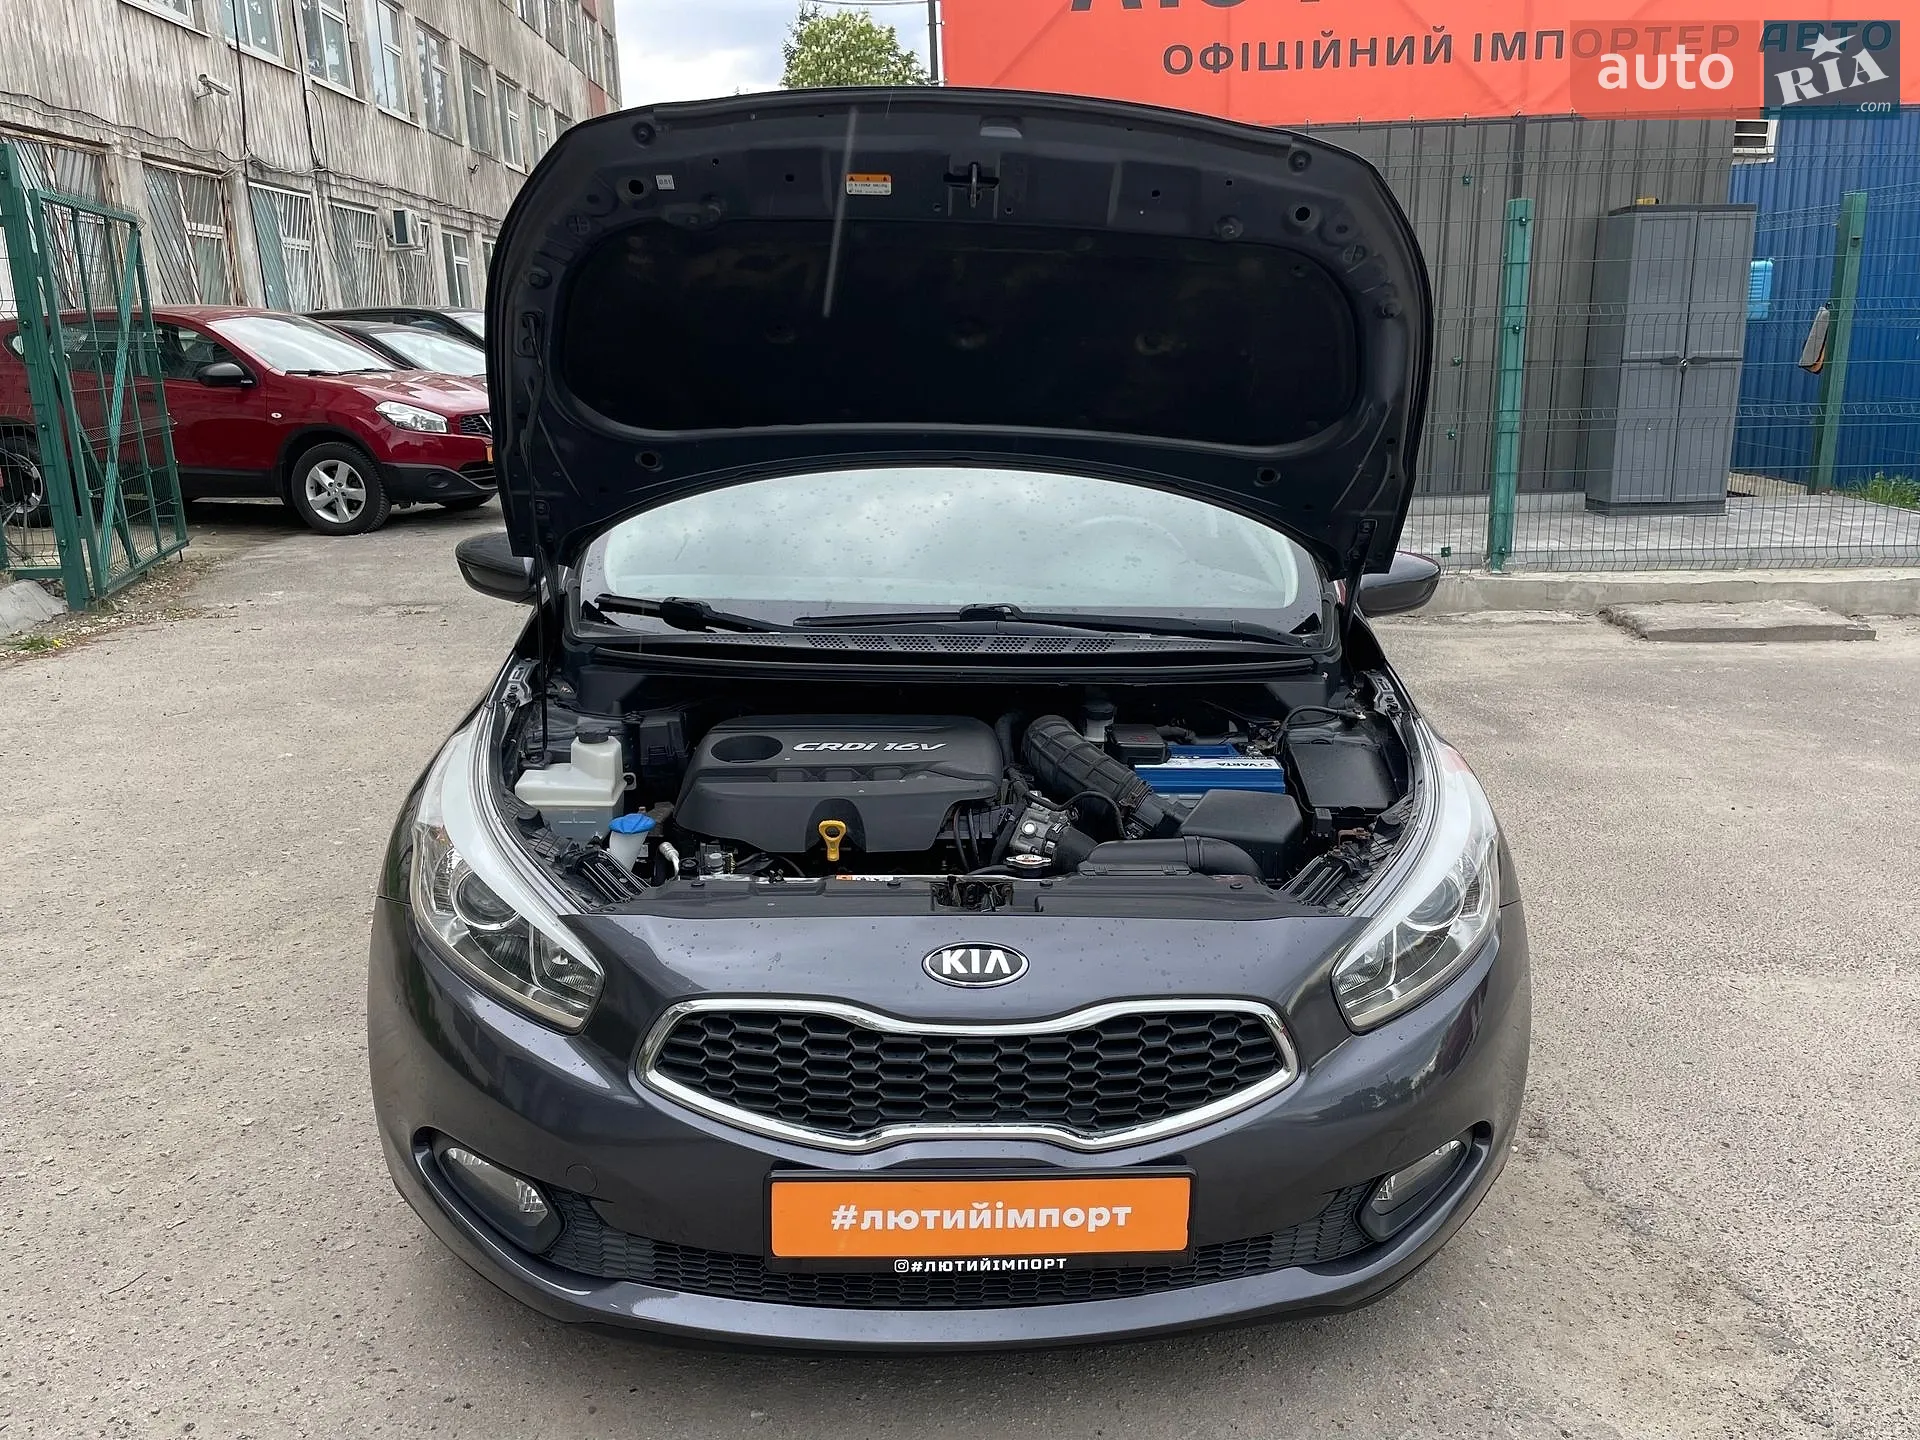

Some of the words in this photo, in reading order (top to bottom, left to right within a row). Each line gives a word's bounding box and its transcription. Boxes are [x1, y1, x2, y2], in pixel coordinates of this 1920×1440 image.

[1162, 25, 1453, 76] ОФІЦІЙНИЙ
[1473, 23, 1740, 63] ІМПОРТЕР
[1758, 20, 1892, 53] АВТО
[883, 742, 947, 752] 16V
[941, 948, 1011, 975] KIA
[831, 1201, 1132, 1232] #лютийімпорт
[911, 1257, 1067, 1273] #ЛЮТИЙІМПОРТ
